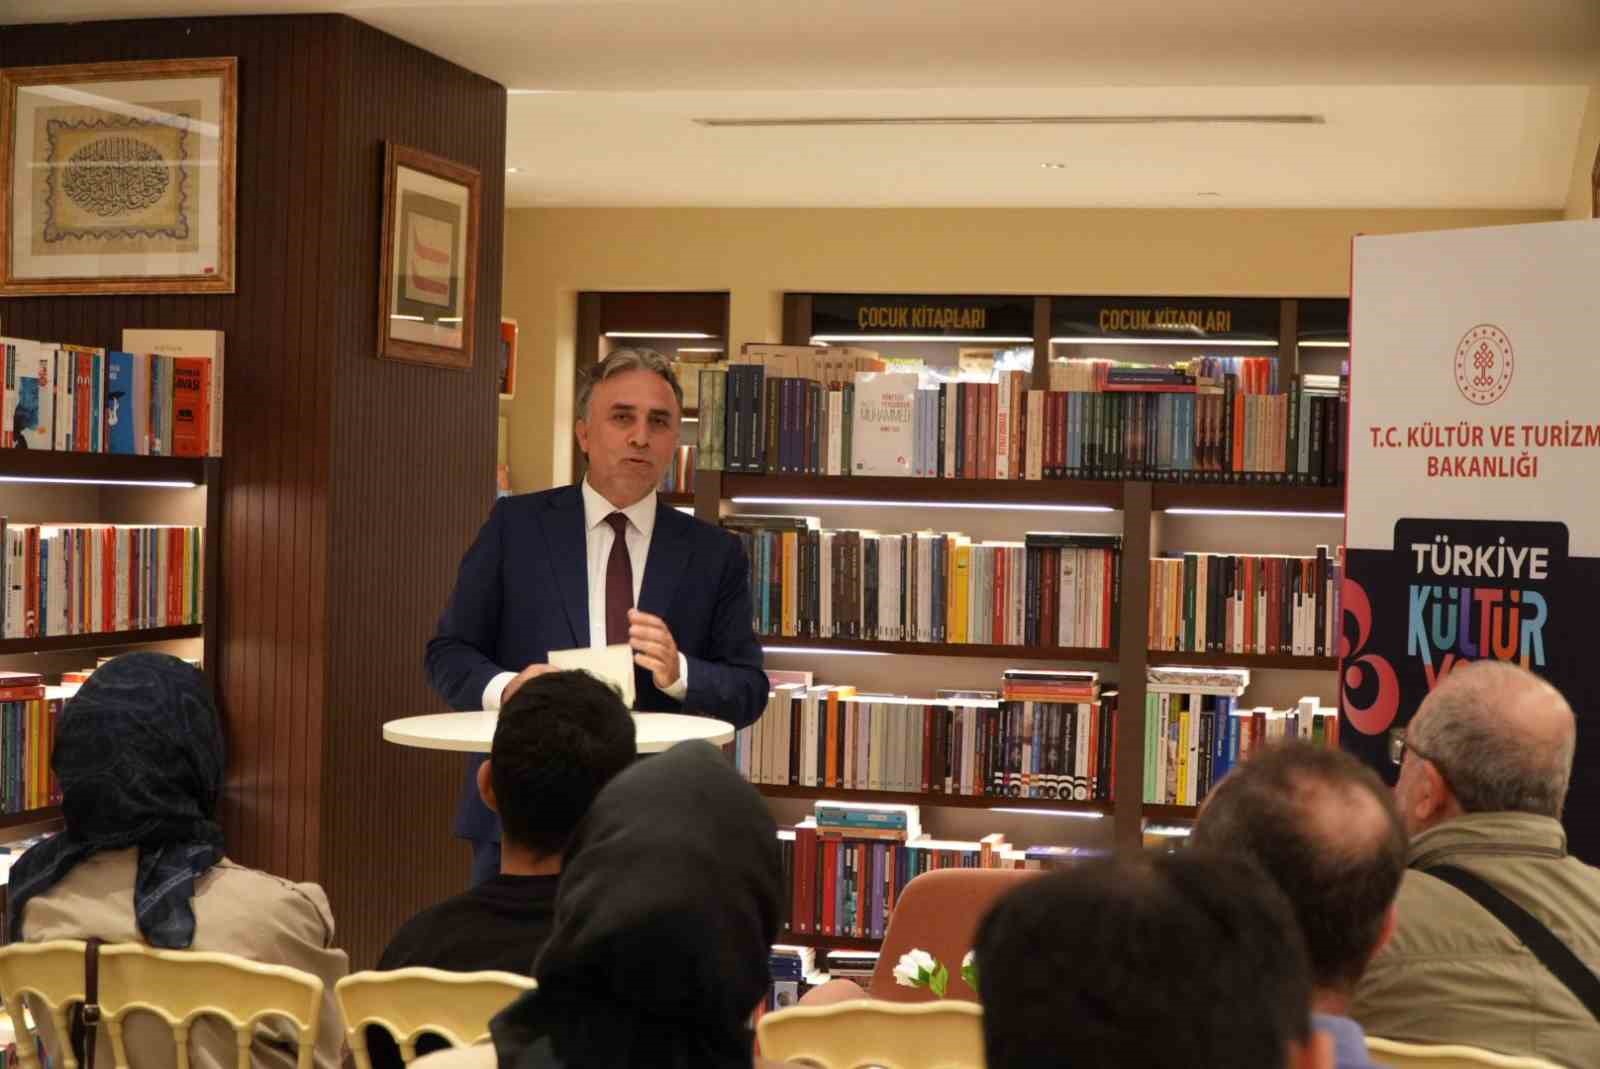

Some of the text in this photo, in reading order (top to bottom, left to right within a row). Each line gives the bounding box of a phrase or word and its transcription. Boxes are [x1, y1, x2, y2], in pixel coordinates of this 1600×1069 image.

[858, 304, 986, 330] ÇOCUK KİTAPLARI
[1154, 307, 1232, 332] KİTAPLARI
[1370, 420, 1600, 447] T.C. KÜLTÜR VE TURİZM
[1427, 452, 1538, 478] BAKANLIĞI
[1411, 534, 1549, 579] TÜRKİYE
[1407, 585, 1548, 666] KÜLTÜR
